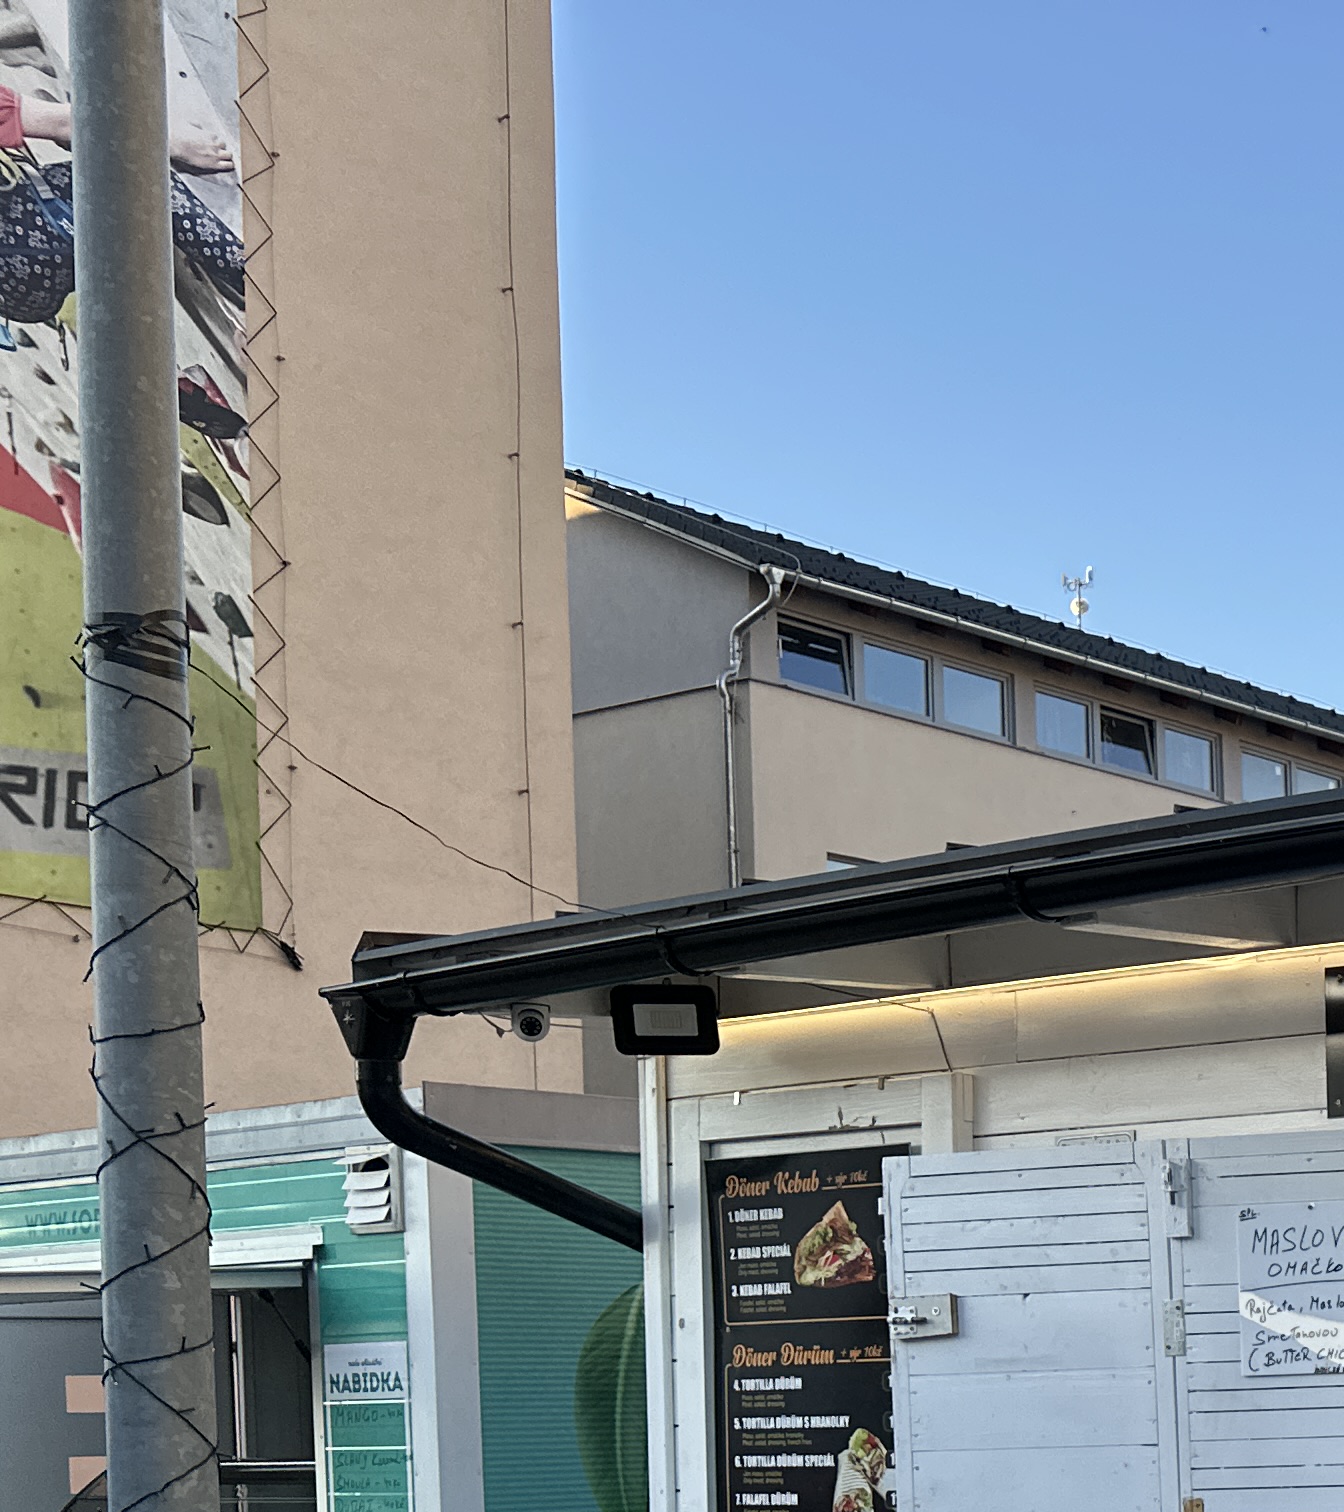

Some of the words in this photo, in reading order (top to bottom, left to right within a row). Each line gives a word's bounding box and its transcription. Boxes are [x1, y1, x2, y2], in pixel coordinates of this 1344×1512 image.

[725, 1175, 770, 1198] Döner
[773, 1169, 820, 1195] Kebab
[732, 1344, 776, 1367] Döner
[780, 1342, 834, 1367] Dürüm
